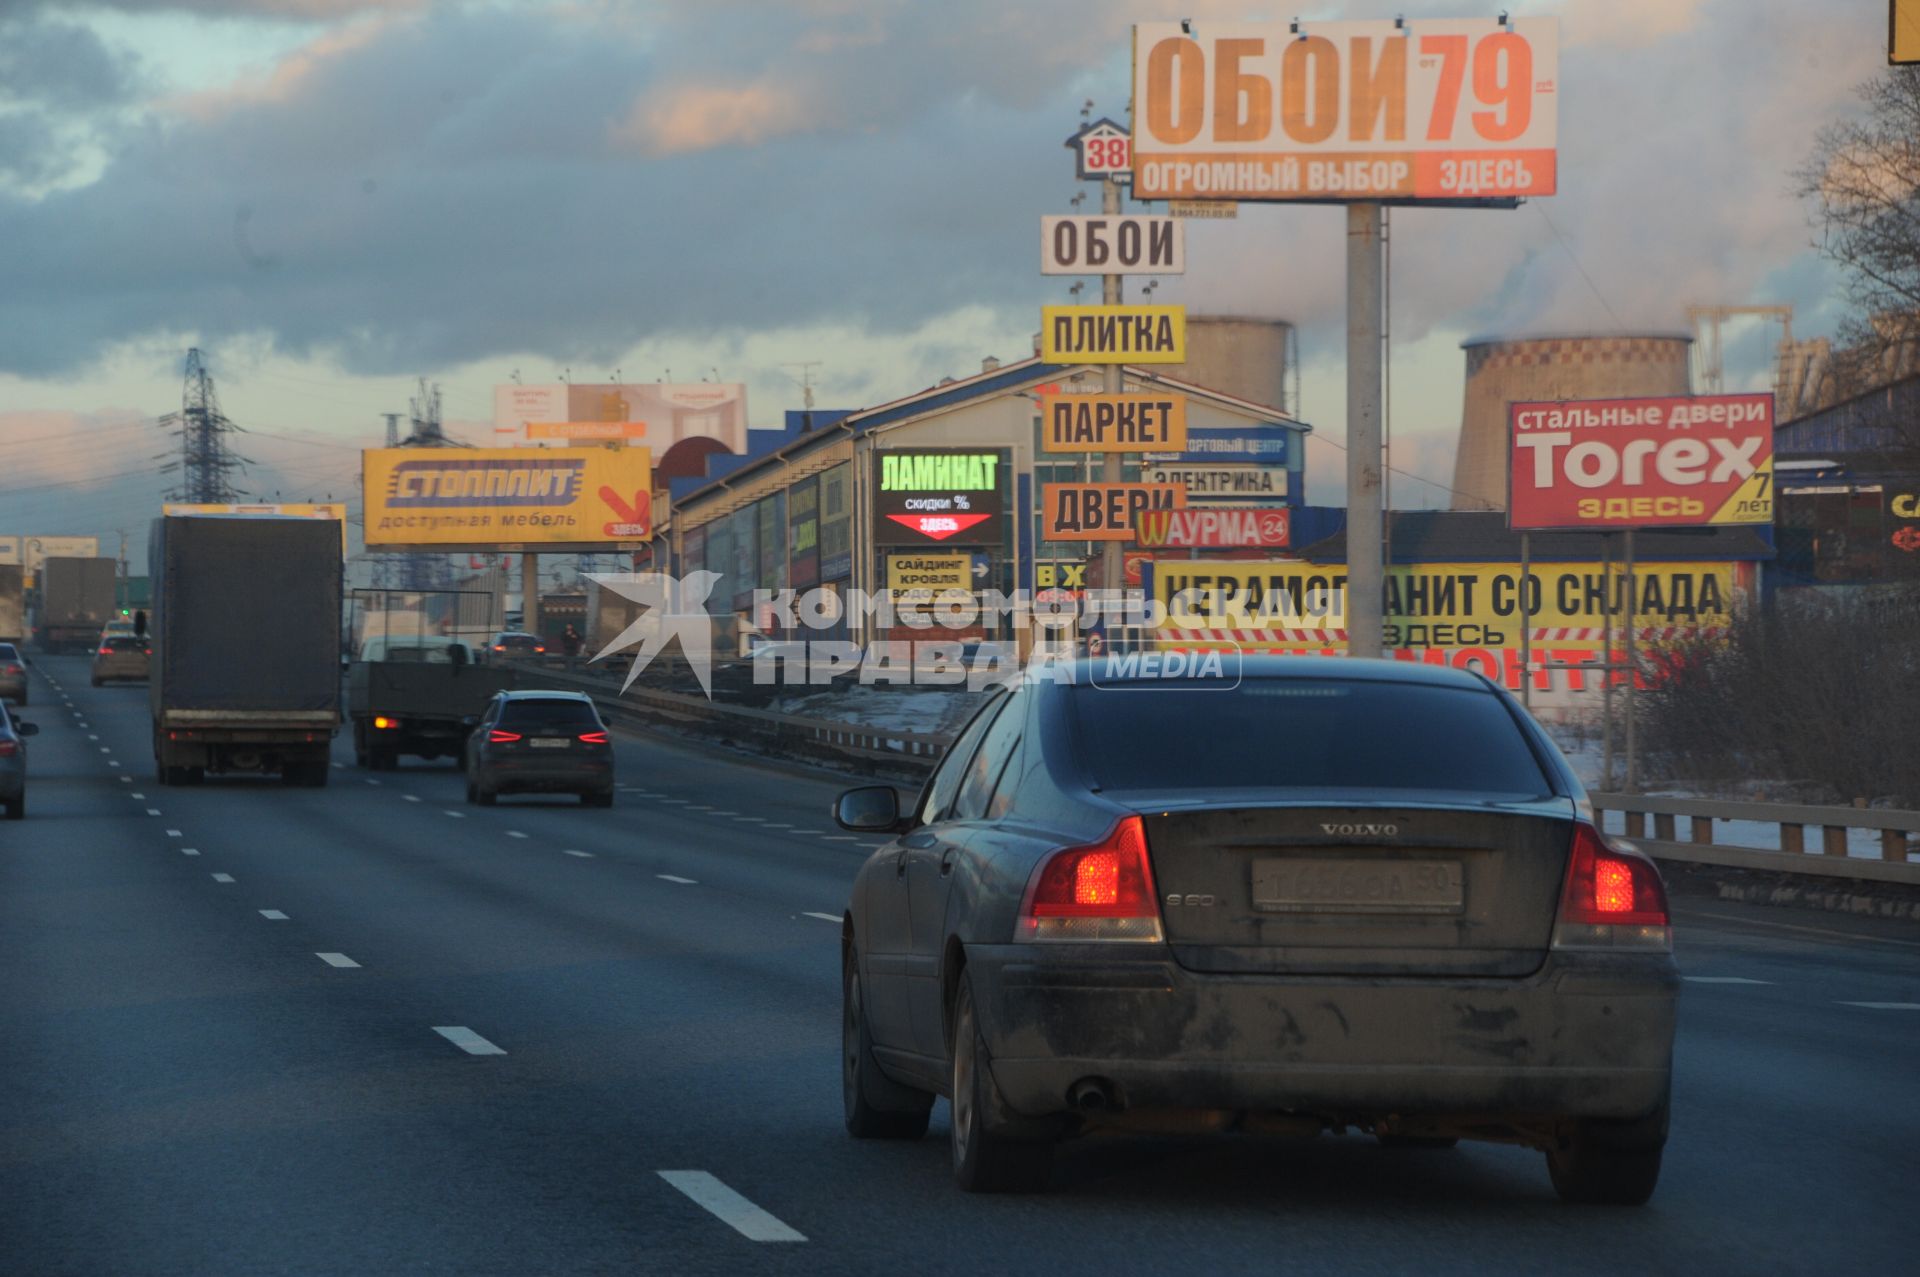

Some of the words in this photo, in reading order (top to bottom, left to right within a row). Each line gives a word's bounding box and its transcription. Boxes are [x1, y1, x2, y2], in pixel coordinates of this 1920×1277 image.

[1146, 36, 1408, 144] ОБОИ
[1419, 31, 1533, 142] 79
[1142, 157, 1299, 193] ОГРОМНЫЙ
[1307, 160, 1408, 192] ВЫБОР
[1439, 159, 1533, 195] ЗДЕСЬ
[1053, 219, 1174, 267] ОБОИ
[1053, 314, 1175, 353] ПЛИТКА
[1053, 401, 1173, 443] ПАРКЕТ
[1516, 405, 1663, 430] стальные
[1668, 401, 1766, 431] двери
[1187, 437, 1244, 453] ОРГОВЫЙ
[1516, 431, 1764, 489] Torex
[881, 454, 999, 491] ЛАМИНАТ
[1154, 471, 1274, 492] ЭЛЕКТРИКА
[1754, 473, 1772, 500] 7
[1578, 496, 1705, 519] ЗДЕСЬ
[1736, 499, 1771, 513] лет
[378, 514, 492, 530] доступная
[501, 511, 577, 528] мебель
[611, 523, 645, 536] ЗДЕСЬ
[919, 518, 959, 532] ЗДЕСЬ
[1263, 520, 1285, 535] 24
[895, 558, 964, 571] САЙДИНГ
[899, 574, 961, 584] КРОВЛЯ
[1166, 572, 1480, 618] КЕРАМОГАНИТ
[1491, 573, 1543, 617] СО
[1557, 573, 1723, 623] СКЛАДА
[1382, 623, 1505, 647] ЗДЕСЬ
[1319, 823, 1399, 836] VOLVO
